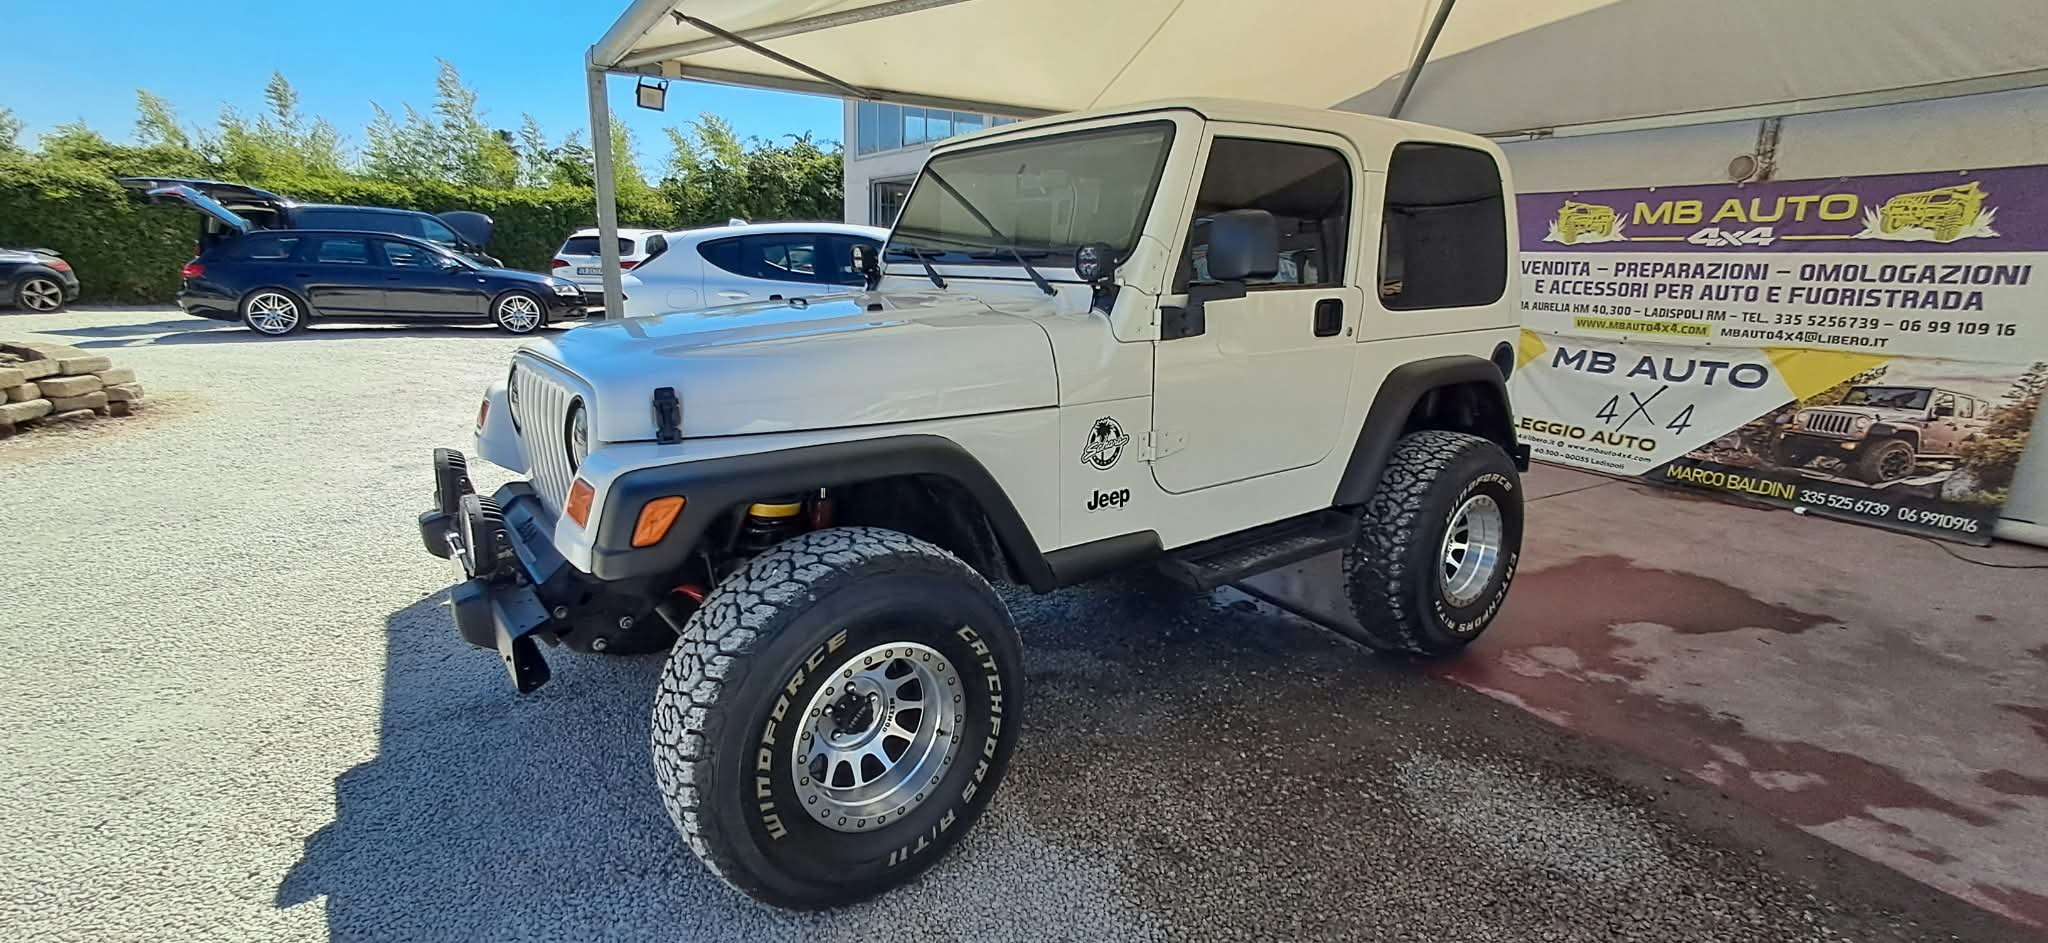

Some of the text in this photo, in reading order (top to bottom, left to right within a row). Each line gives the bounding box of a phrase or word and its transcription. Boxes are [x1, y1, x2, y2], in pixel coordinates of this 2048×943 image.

[1632, 193, 1859, 225] MB AUTO
[1521, 261, 1591, 276] VENDITA
[1613, 261, 1769, 280] PREPARAZIONI
[1799, 263, 2032, 285] OMOLOGAZIONI
[1535, 279, 1983, 311] E ACCESSORI PER AUTO E FUORISTRADA
[1531, 301, 1570, 313] AURELIA
[1573, 303, 1589, 314] KM
[1644, 307, 1703, 320] LADISPOLI
[1706, 310, 1726, 321] RM
[1742, 312, 1769, 324] TEL.
[1774, 313, 1803, 325] 335
[1807, 315, 1879, 330] 5256739
[1900, 319, 1921, 332] 06
[1927, 321, 1950, 333] 99
[1957, 322, 1990, 335] 109
[1996, 323, 2016, 337] 16
[1552, 346, 1769, 389] MB AUTO
[1515, 417, 1656, 452] EGGIO AUTO
[1567, 444, 1652, 463] www.mbauto4x4.com
[1590, 457, 1625, 470] Ladispoli
[1087, 488, 1130, 511] Jeep
[1666, 463, 1979, 534] MARCO BALDINI 335 525 6739 06 9910916
[956, 624, 1002, 804] CATCHFORS
[755, 628, 849, 841] WINDFORCE
